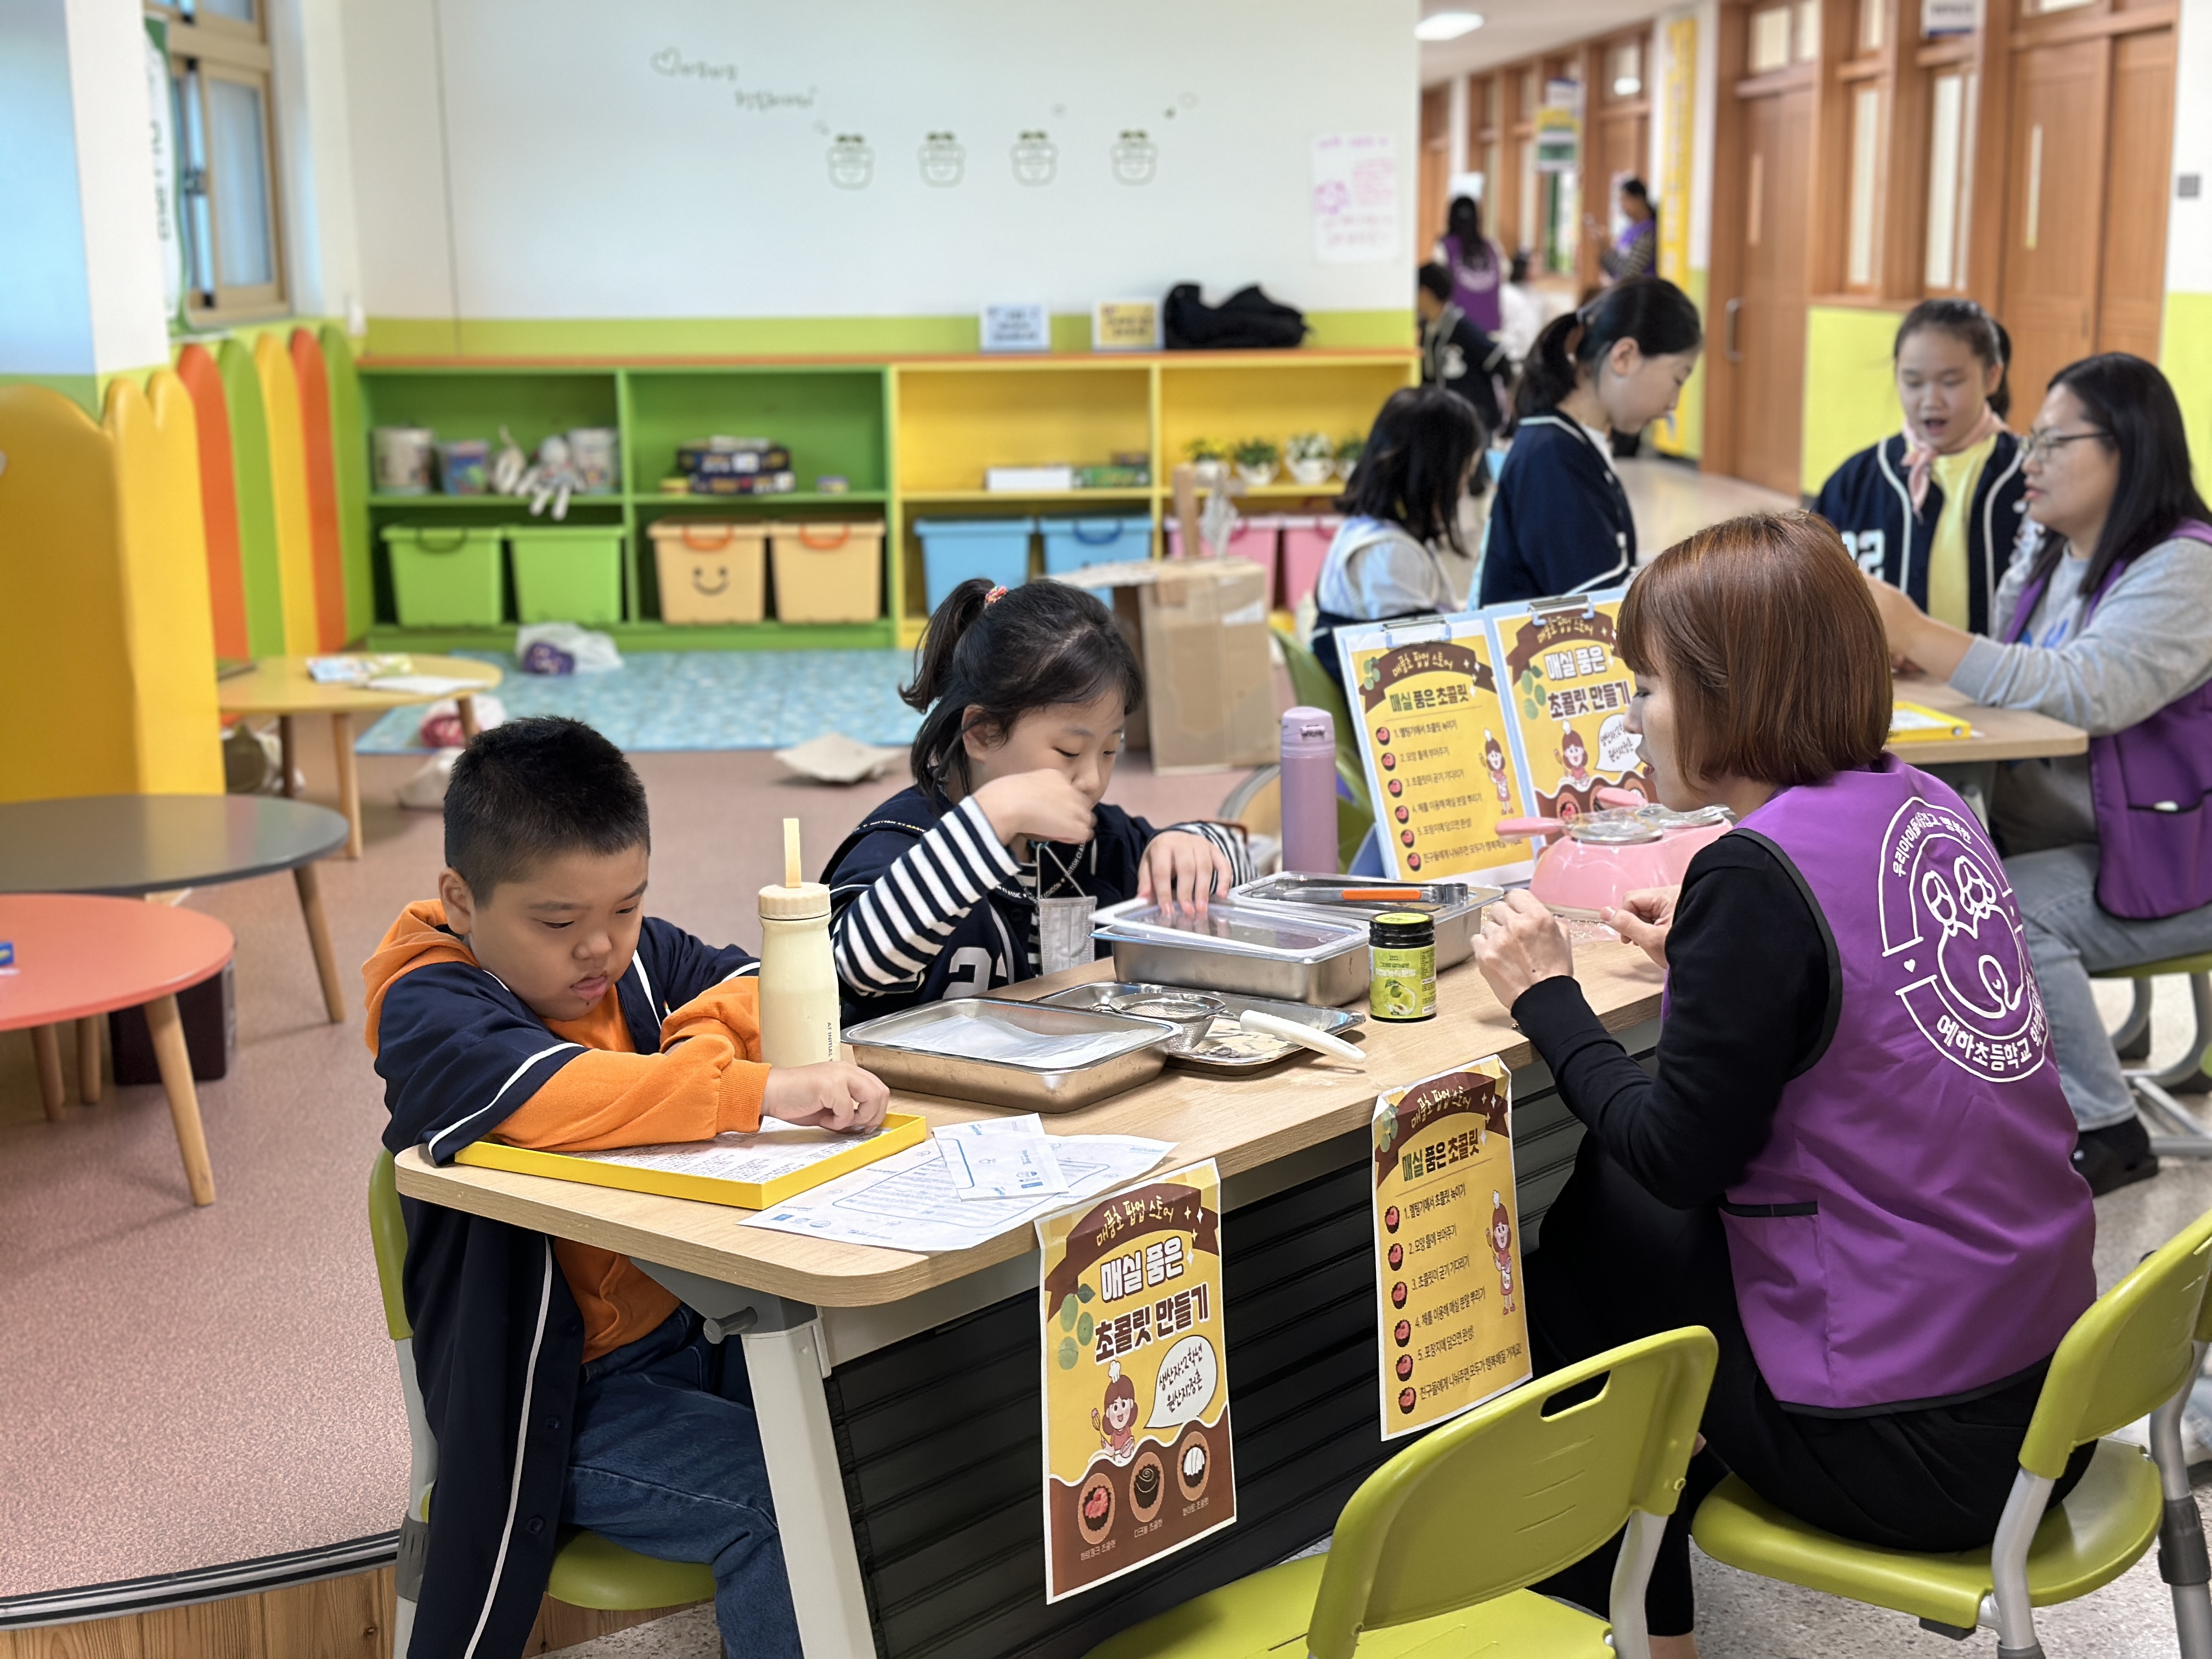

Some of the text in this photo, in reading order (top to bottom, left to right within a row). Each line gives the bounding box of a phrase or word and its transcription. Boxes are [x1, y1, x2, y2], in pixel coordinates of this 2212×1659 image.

[1413, 651, 1430, 668] 팝업
[1432, 651, 1454, 670] 스토어
[1544, 646, 1606, 680] 매실 품은
[1390, 684, 1469, 712] 매실 품은 초콜릿
[1548, 680, 1631, 719] 초콜릿 만들기
[1393, 719, 1458, 738] 1. 멜팅기에서 초콜릿 녹이기
[1400, 747, 1450, 762] 2. 모양 틀에 부어주기
[1405, 769, 1465, 787] 3. 초콜릿이 굳기 기다리기
[1429, 799, 1446, 811] 이용해
[1444, 797, 1457, 808] 매실
[1456, 795, 1467, 806] 분말
[1466, 793, 1483, 804] 뿌리기
[1417, 827, 1423, 836] 5.
[1423, 823, 1446, 835] 포장지에
[1444, 820, 1460, 832] 담으면
[1423, 850, 1449, 864] 친구들에게
[1469, 842, 1485, 854] 모두가
[1937, 1014, 2032, 1071] 예하초등학교
[1402, 1128, 1480, 1182] 매실 품은 초콜릿
[1122, 1199, 1145, 1226] 팝업
[1149, 1195, 1174, 1223] 스토어
[1404, 1207, 1410, 1220] 1.
[1435, 1188, 1451, 1206] 초콜릿
[1450, 1182, 1466, 1201] 녹이기
[1408, 1223, 1457, 1255] 2. 모양 틀에 부어주기
[1100, 1237, 1184, 1303] 매실 품은
[1412, 1254, 1470, 1290] 3. 초콜릿이 굳기 기다리기
[1095, 1283, 1209, 1362] 초콜릿 만들기
[1415, 1317, 1421, 1328] 4.
[1433, 1302, 1449, 1322] 이용해
[1459, 1293, 1470, 1311] 분말
[1470, 1285, 1486, 1305] 뿌리기
[1418, 1348, 1424, 1361] 5.
[1424, 1337, 1447, 1359] 포장지에
[1446, 1331, 1463, 1350] 담으면
[1419, 1375, 1449, 1401] 친구들에게
[1469, 1358, 1486, 1378] 모두가
